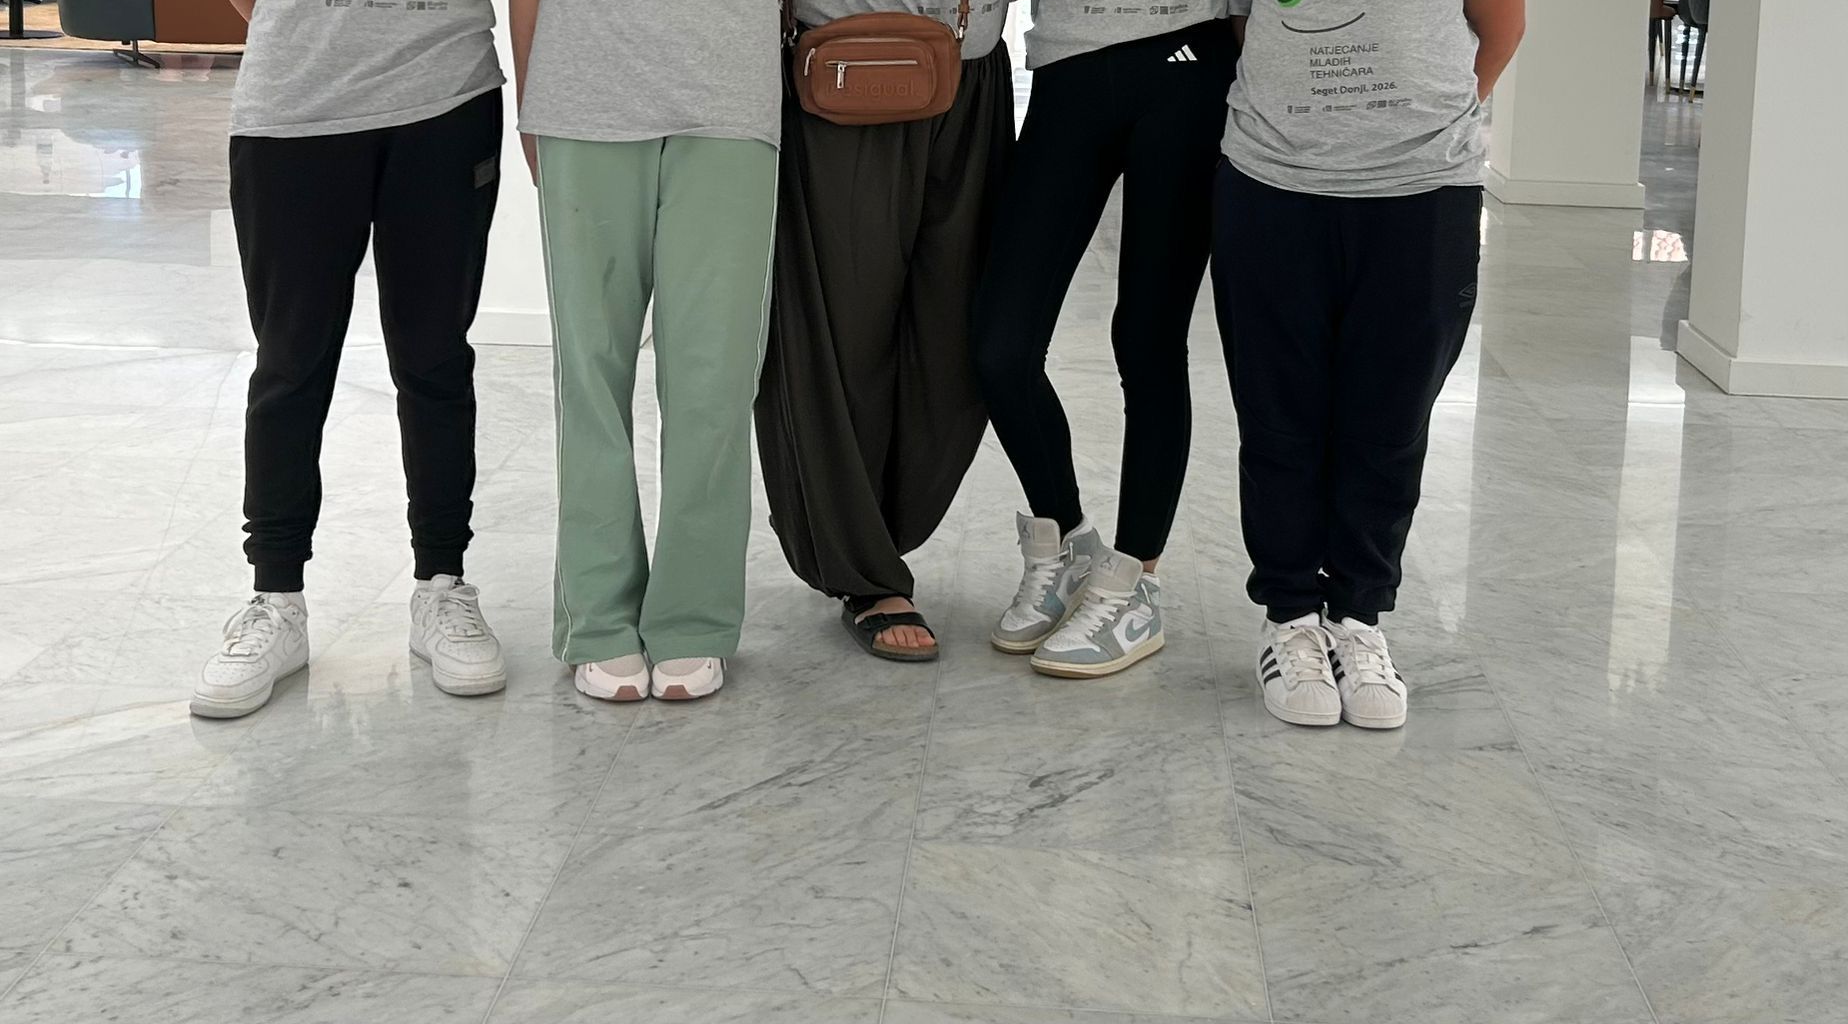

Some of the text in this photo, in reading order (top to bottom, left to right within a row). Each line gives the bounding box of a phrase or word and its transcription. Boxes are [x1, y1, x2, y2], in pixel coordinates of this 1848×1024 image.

[1309, 43, 1380, 55] NATJECANJE
[1309, 57, 1351, 67] MLADIH
[1309, 66, 1374, 79] TEHNIČARA
[1310, 86, 1338, 96] Seget
